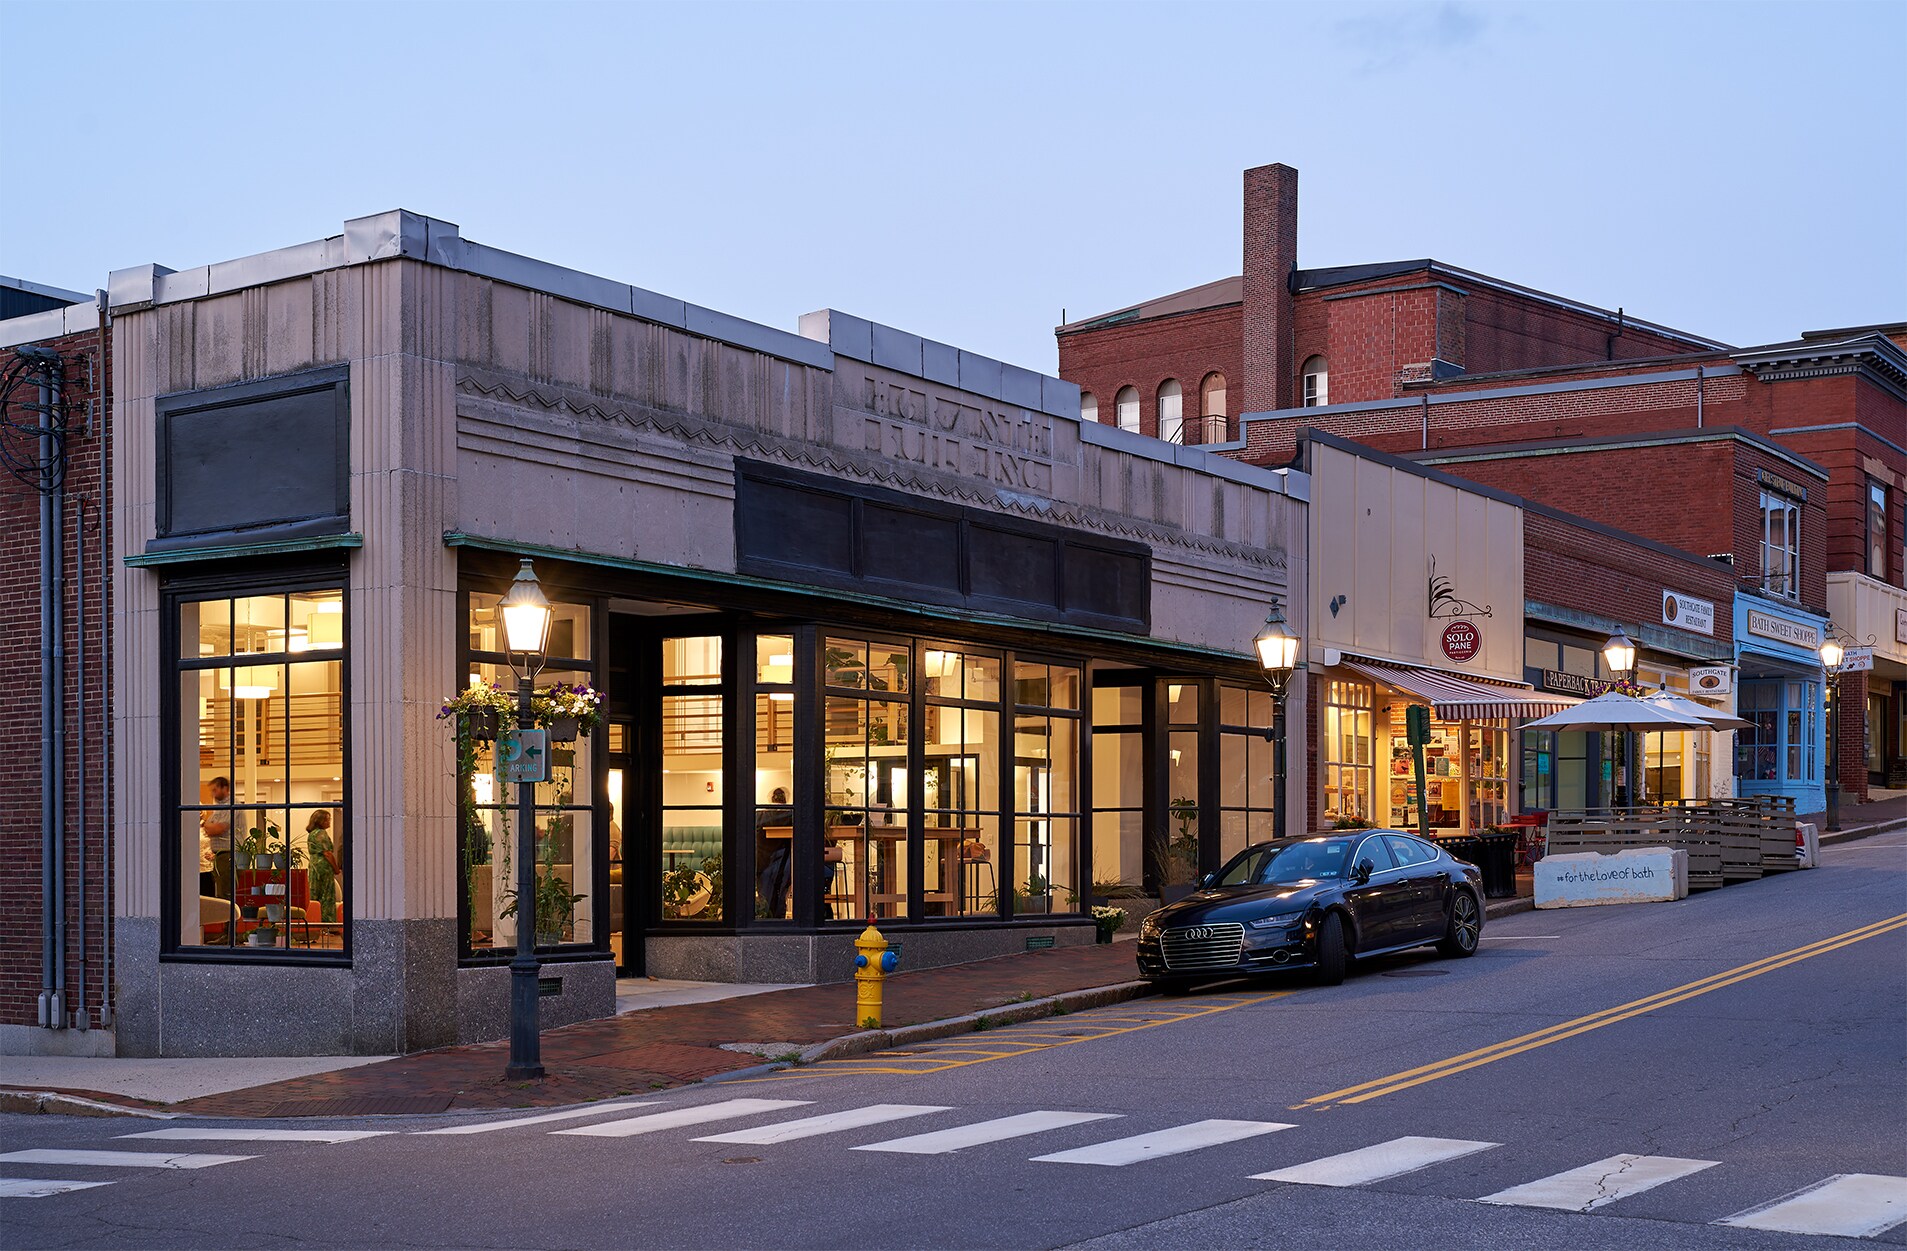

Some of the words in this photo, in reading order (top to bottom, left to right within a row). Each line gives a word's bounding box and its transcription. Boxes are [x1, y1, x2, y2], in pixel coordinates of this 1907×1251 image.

[880, 421, 1041, 490] BUILDING
[1679, 599, 1700, 614] SOUTHGATE
[1752, 615, 1769, 631] BATH
[1770, 621, 1792, 637] SWEET
[1793, 627, 1816, 644] SHOPPE
[1446, 632, 1474, 643] SOLO
[1449, 641, 1472, 650] PANE
[1849, 654, 1870, 662] SHOPPE
[1692, 669, 1727, 678] SOUTHGATE
[1549, 671, 1590, 695] PAPERBACK
